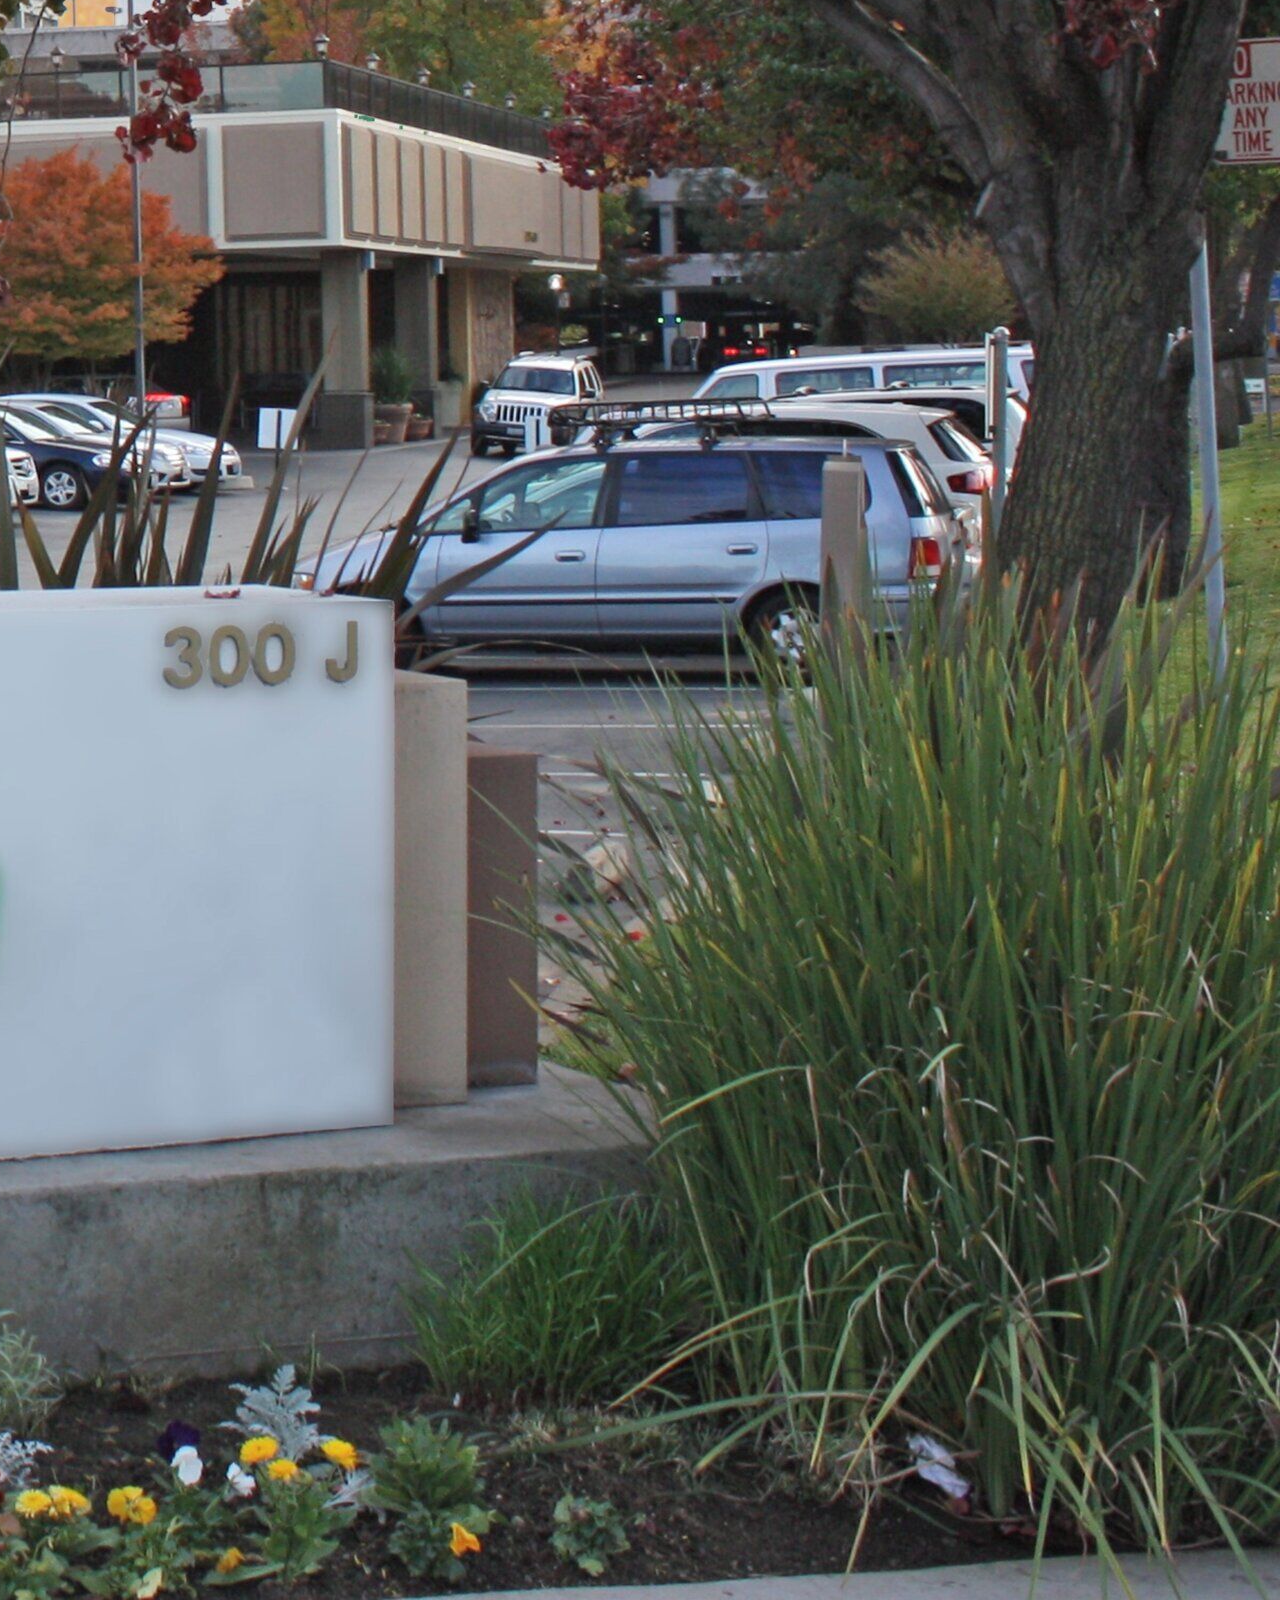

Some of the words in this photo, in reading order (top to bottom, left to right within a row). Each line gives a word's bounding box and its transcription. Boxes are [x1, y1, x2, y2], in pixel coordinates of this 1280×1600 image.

[1226, 81, 1280, 104] ARKIN
[1234, 106, 1269, 129] ANY
[1232, 130, 1273, 153] TIME
[162, 623, 296, 690] 300
[325, 620, 358, 684] J
